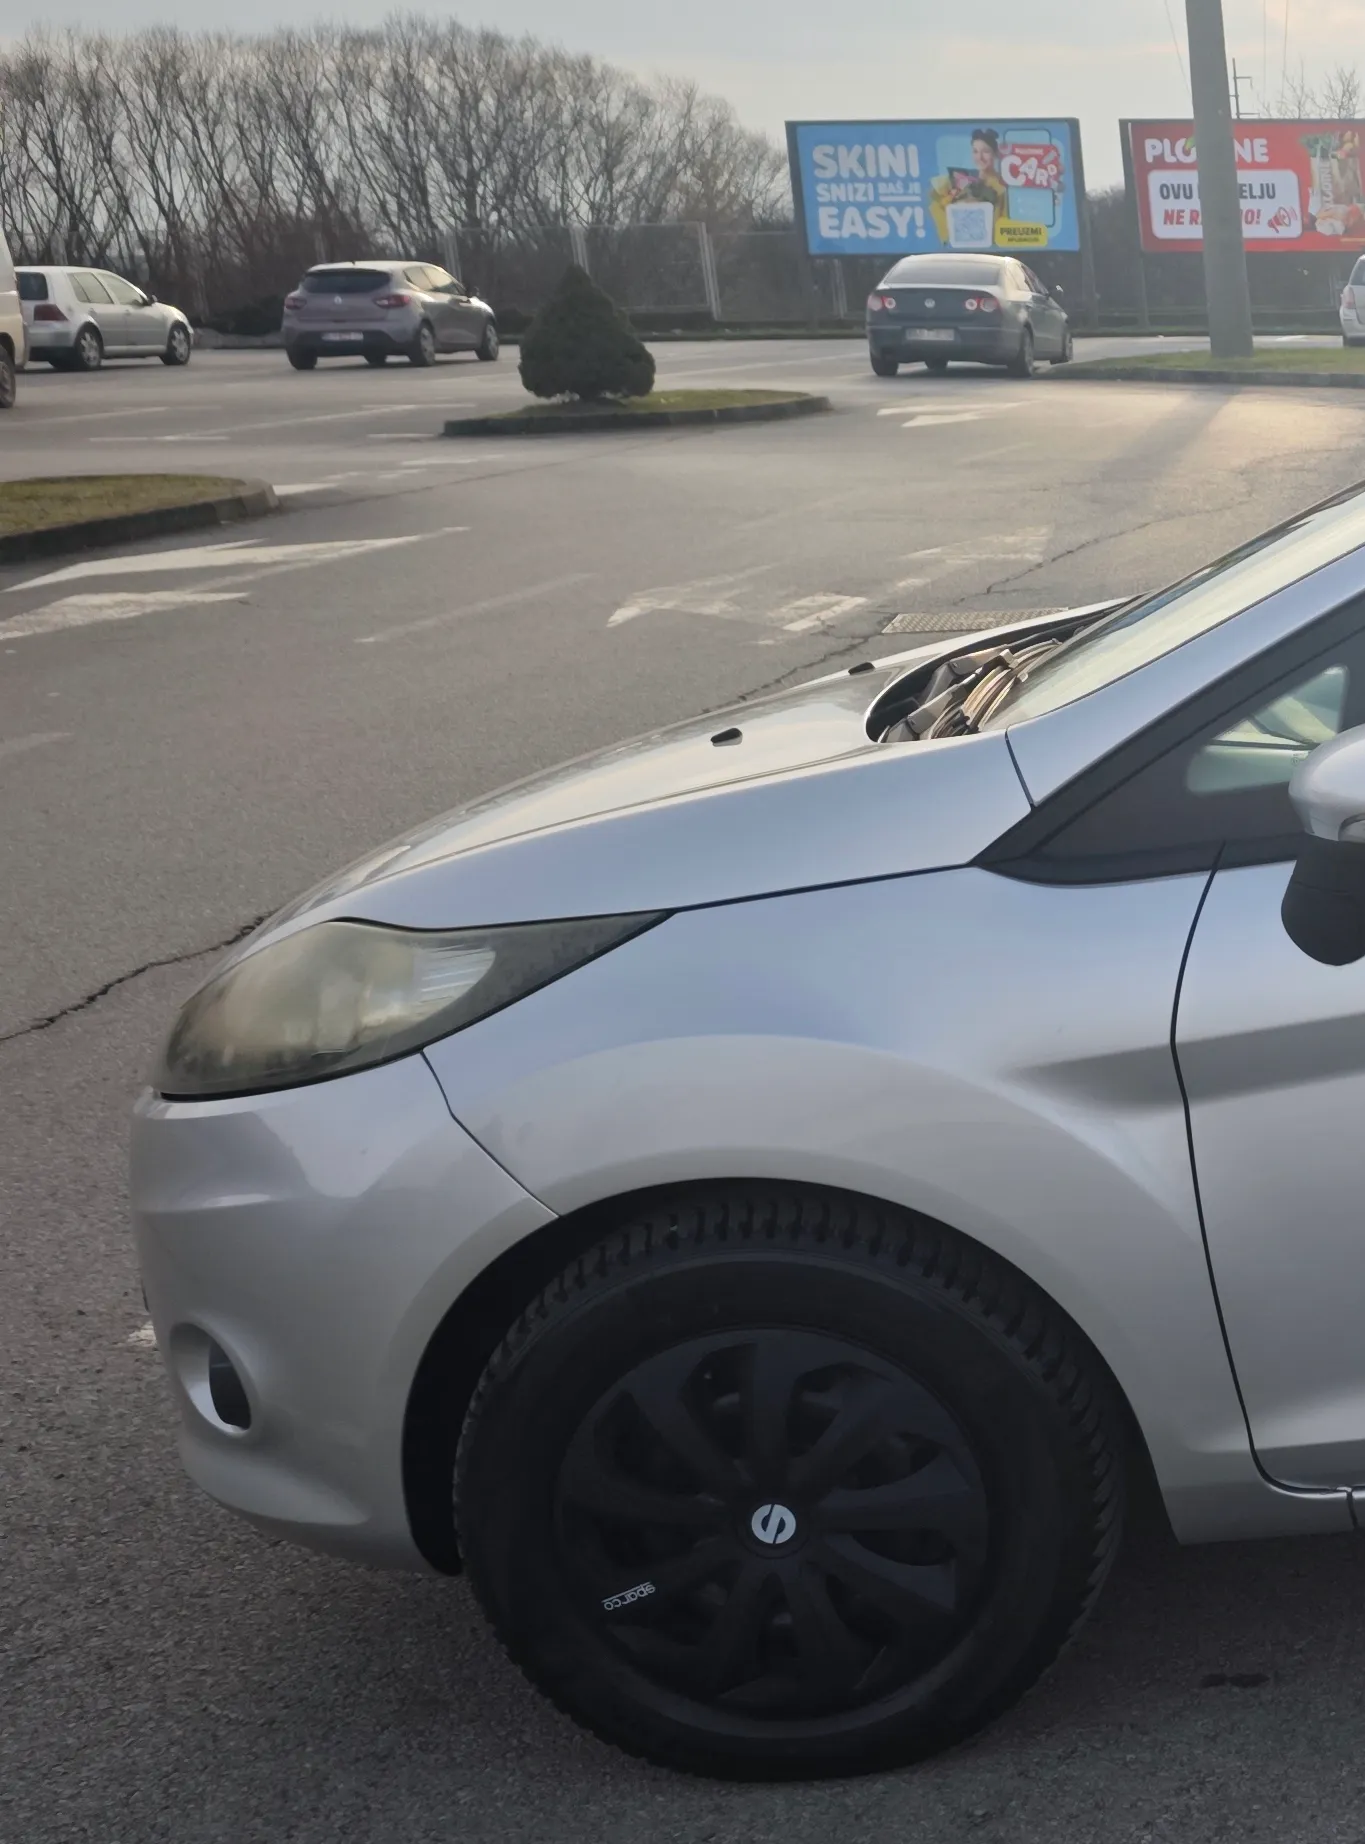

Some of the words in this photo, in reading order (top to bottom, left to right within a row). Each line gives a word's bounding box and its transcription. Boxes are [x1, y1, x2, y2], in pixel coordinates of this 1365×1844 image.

[811, 143, 921, 180] SKINI
[1144, 137, 1269, 163] PLONE
[816, 182, 874, 203] SNIZI
[1159, 183, 1193, 200] OVU
[817, 205, 926, 239] EASY!
[1163, 208, 1186, 225] NE
[602, 1583, 656, 1611] sparco
